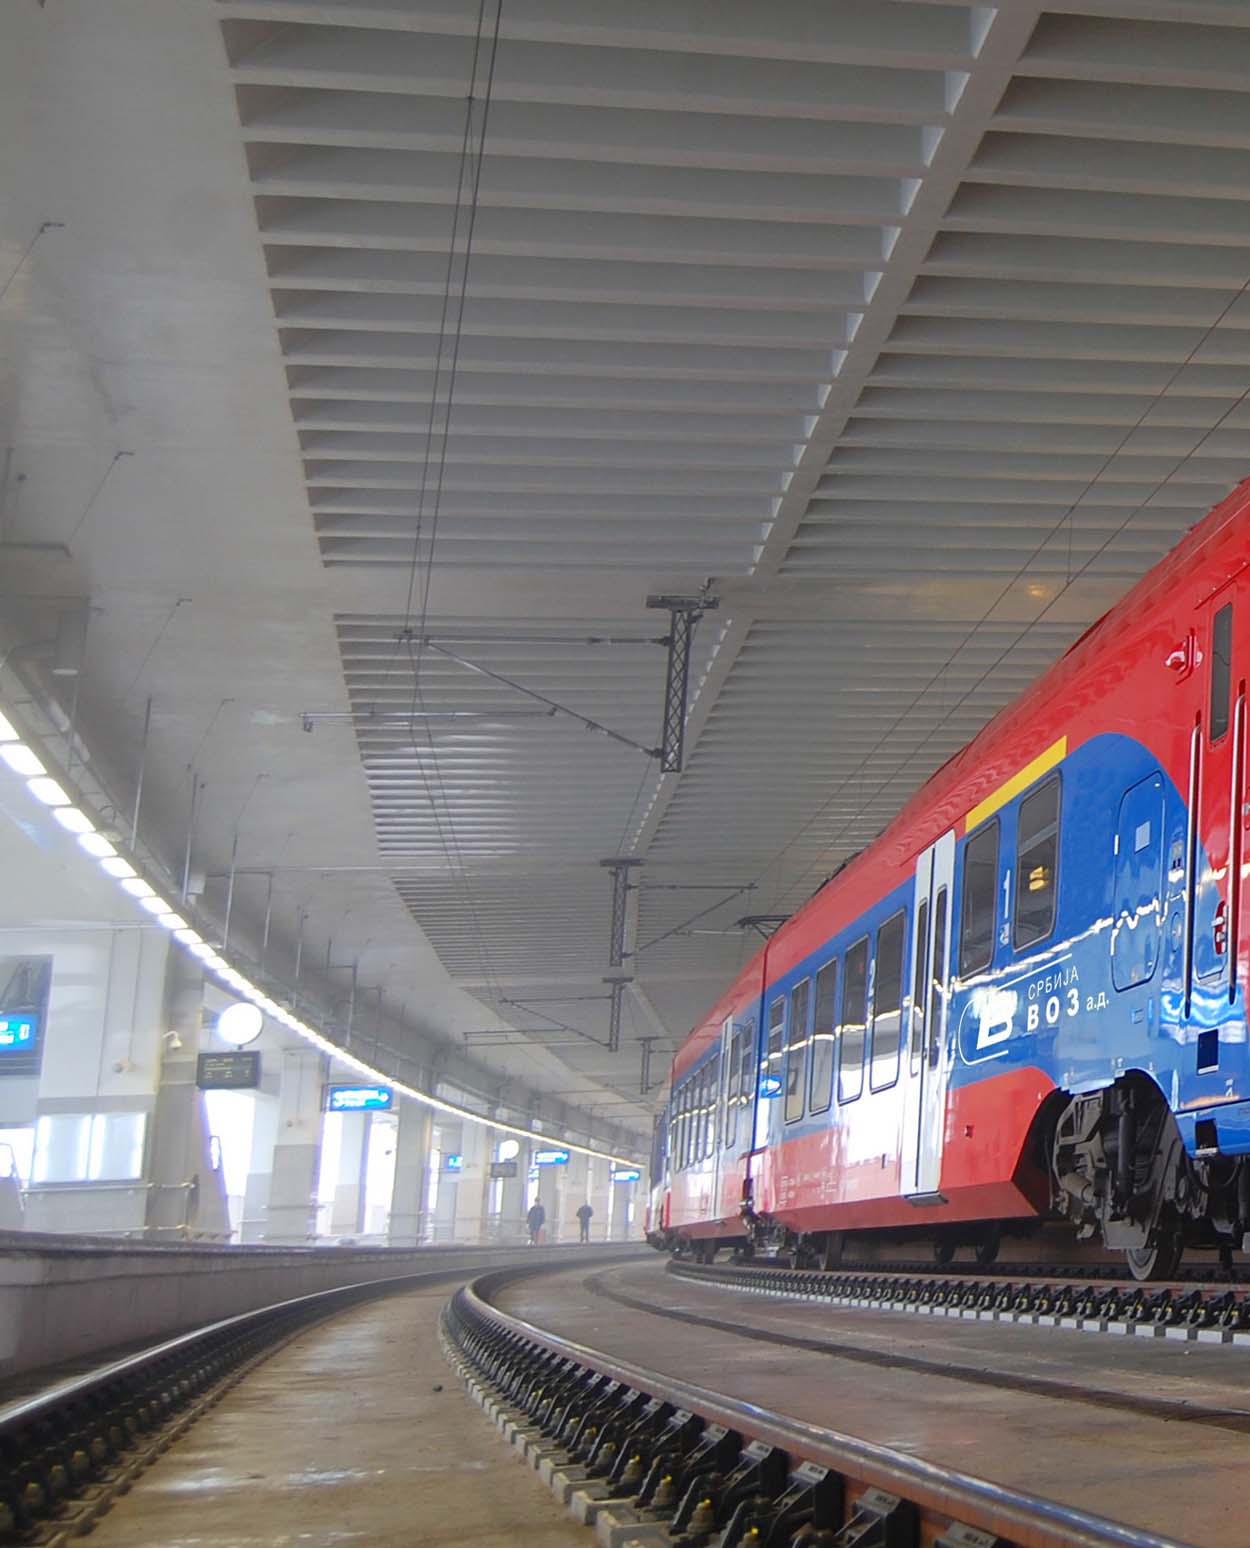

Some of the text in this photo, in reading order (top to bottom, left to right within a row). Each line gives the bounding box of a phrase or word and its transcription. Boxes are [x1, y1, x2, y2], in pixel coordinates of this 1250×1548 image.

[1003, 869, 1011, 919] 1
[1027, 966, 1079, 1000] СРБИЈА
[1085, 991, 1110, 1011] а.д.
